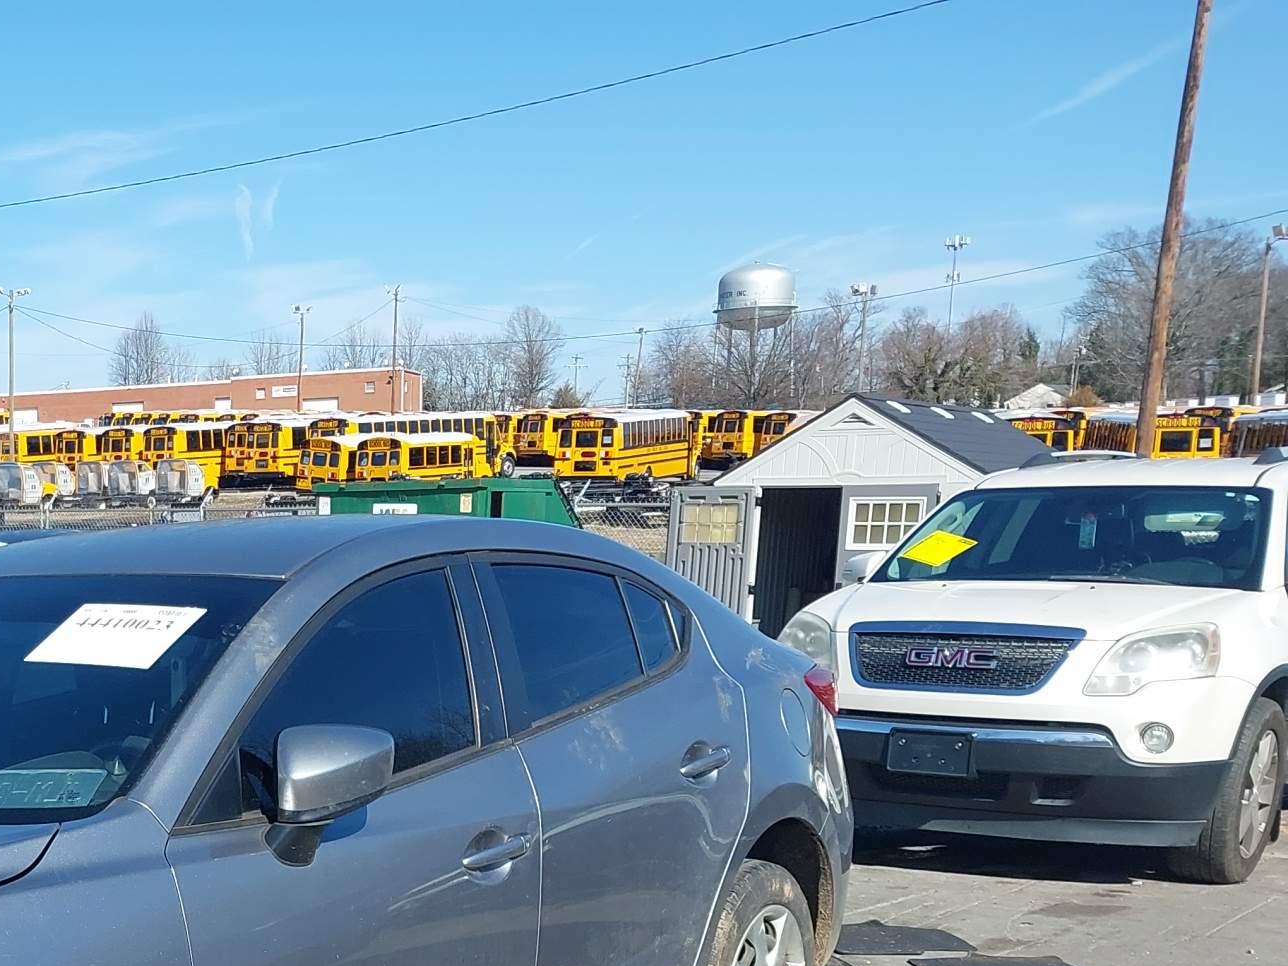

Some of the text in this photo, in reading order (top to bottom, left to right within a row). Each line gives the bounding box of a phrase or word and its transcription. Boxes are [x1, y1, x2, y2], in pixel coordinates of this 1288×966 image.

[1156, 418, 1200, 427] SCHOOL BUS
[905, 645, 1000, 669] GMC
